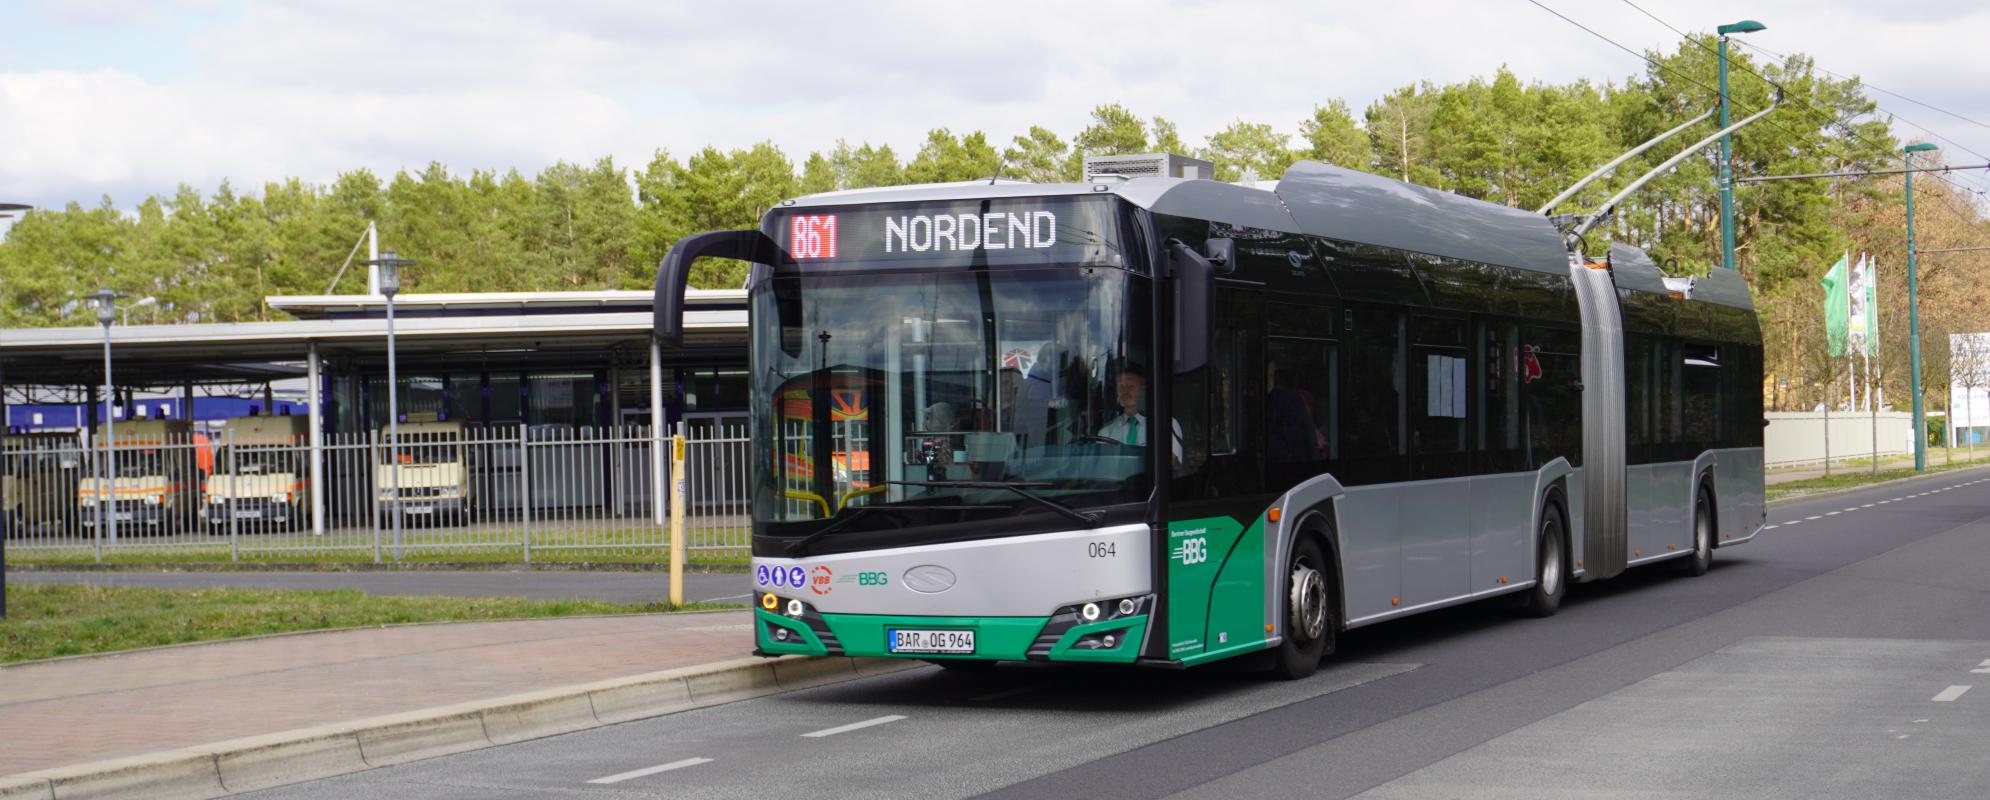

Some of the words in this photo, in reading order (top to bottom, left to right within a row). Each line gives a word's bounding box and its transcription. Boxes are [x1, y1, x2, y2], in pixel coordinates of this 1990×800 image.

[794, 215, 835, 258] 861
[885, 211, 1056, 253] NORDEND
[1088, 542, 1116, 558] 064
[1182, 537, 1207, 565] BBG
[813, 575, 831, 585] VBB
[858, 571, 888, 586] BBG
[896, 632, 920, 648] BAR
[930, 632, 946, 648] OG
[949, 633, 972, 648] 964
